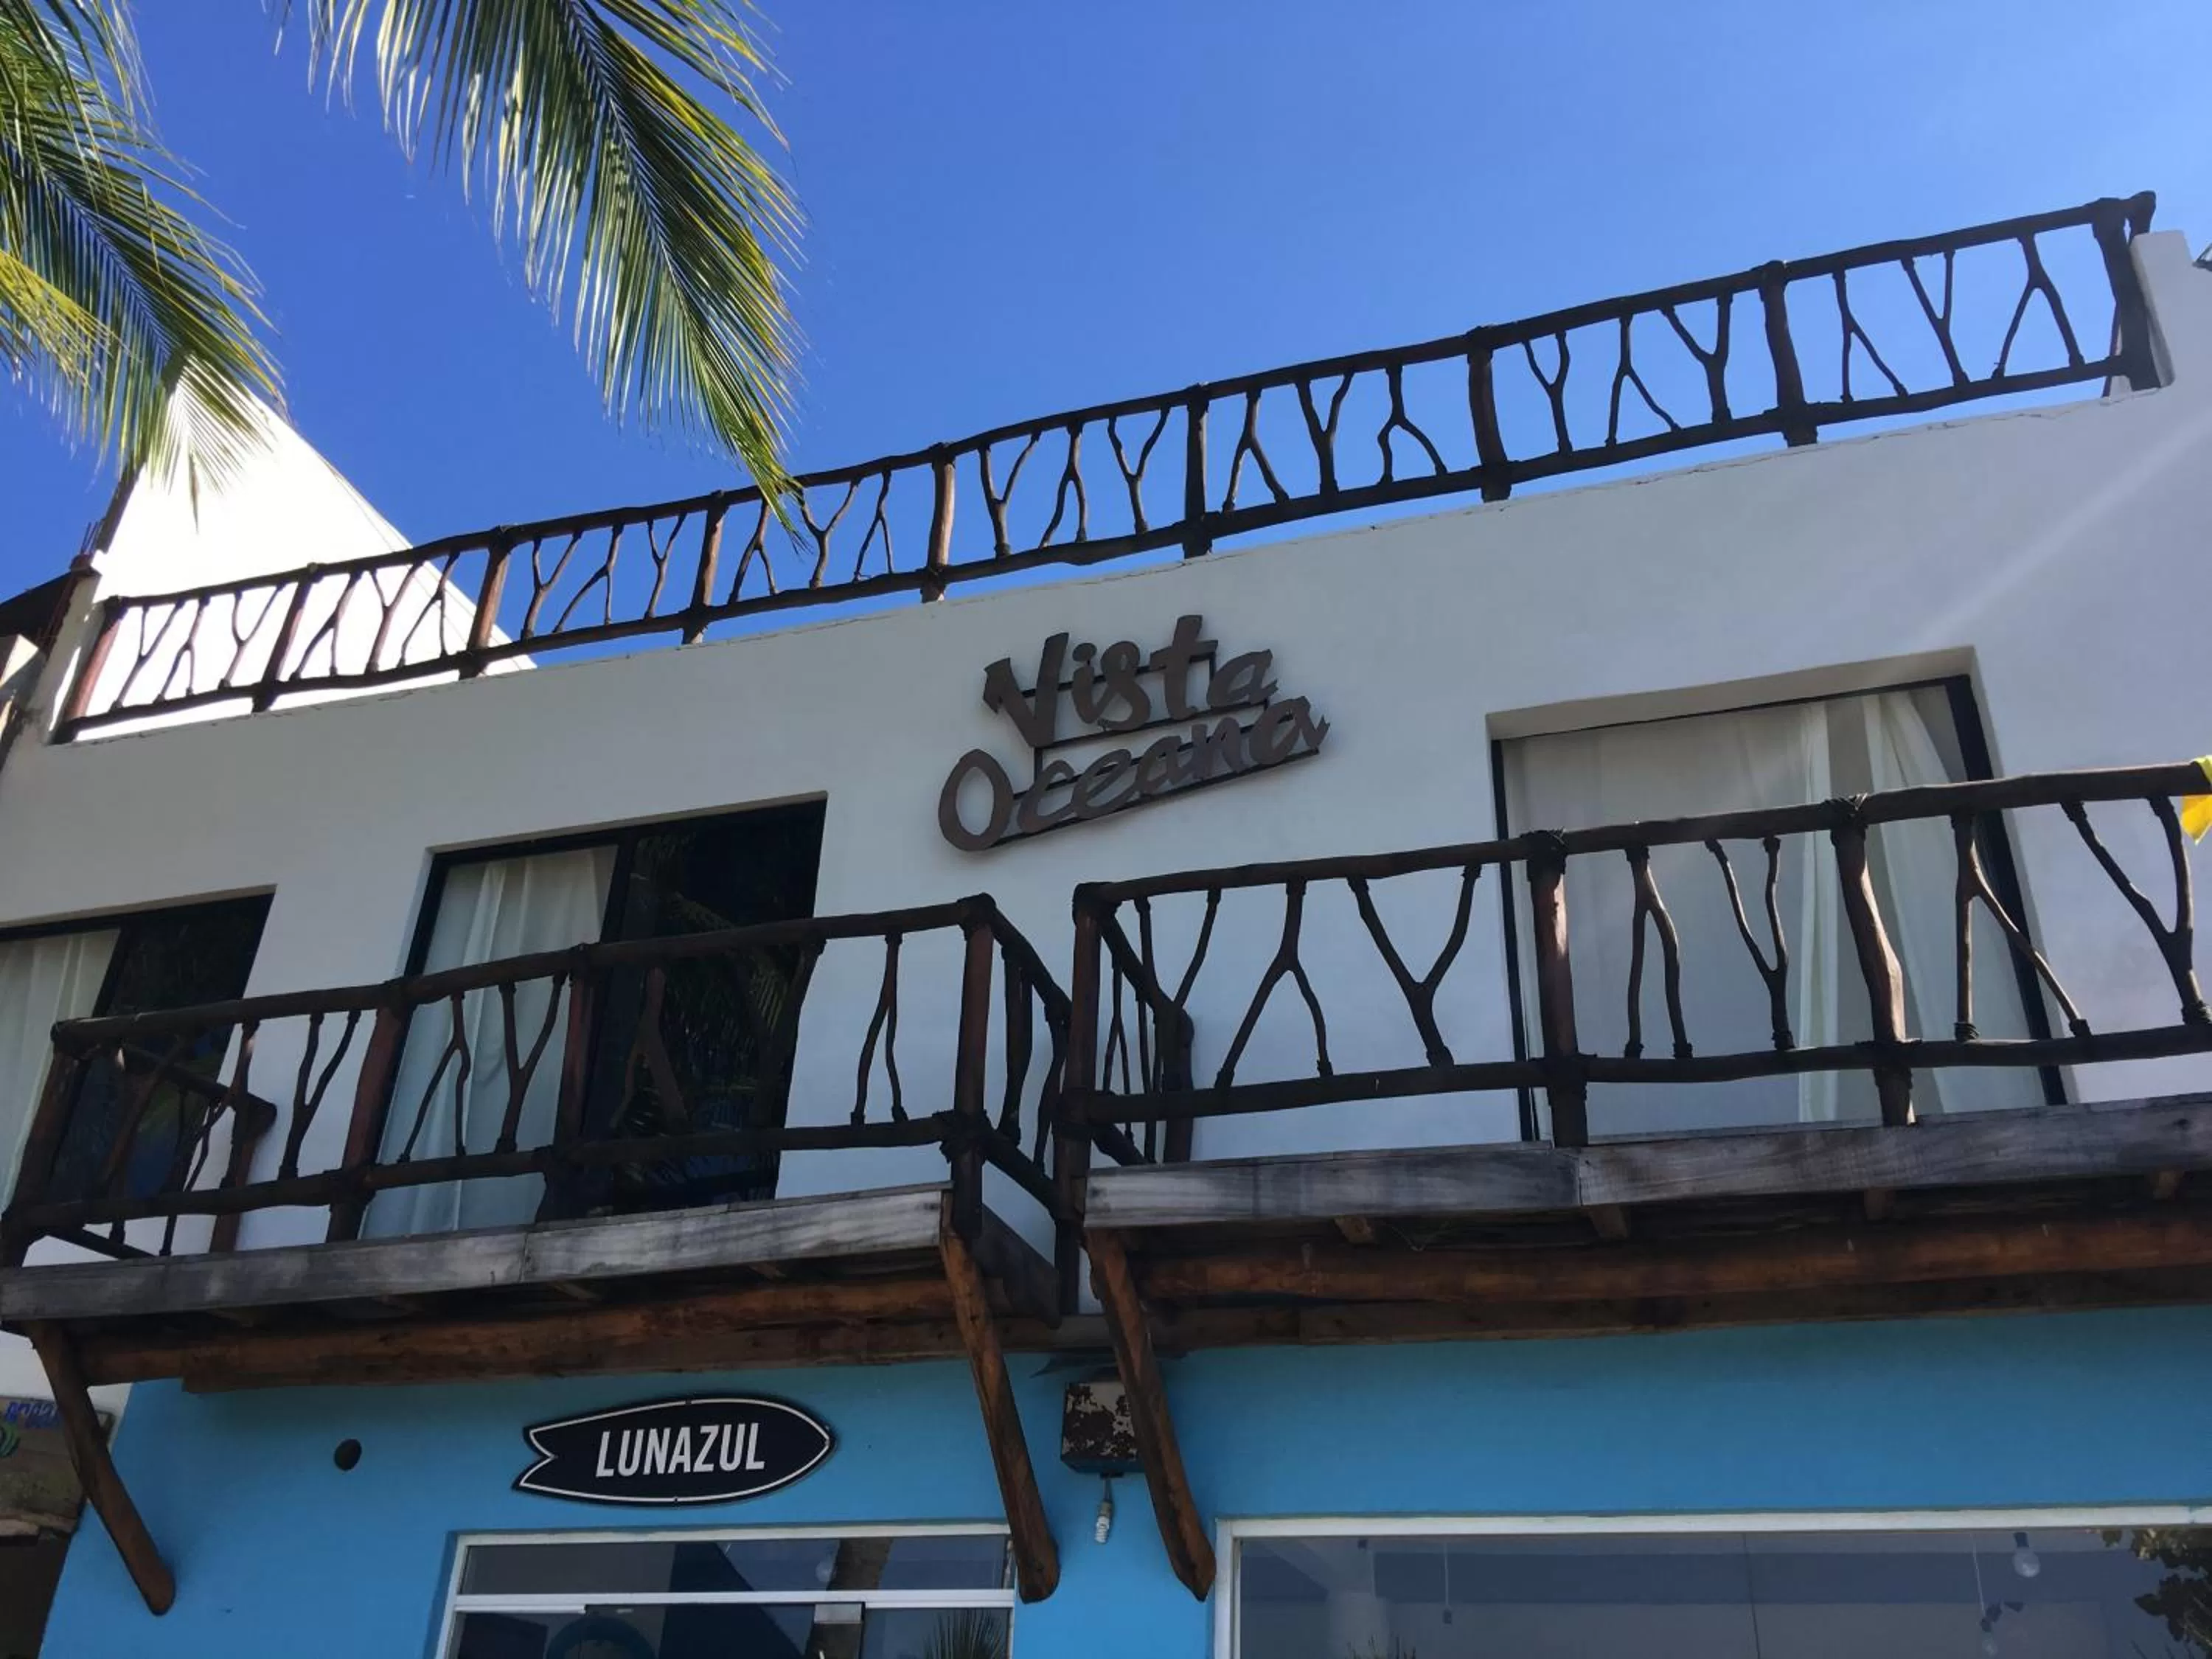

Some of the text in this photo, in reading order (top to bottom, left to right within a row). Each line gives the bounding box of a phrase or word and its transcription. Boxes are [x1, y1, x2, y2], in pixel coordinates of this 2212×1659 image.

[984, 614, 1279, 748] Vista
[938, 695, 1330, 851] Oceana
[596, 1422, 765, 1478] LUNAZUL
